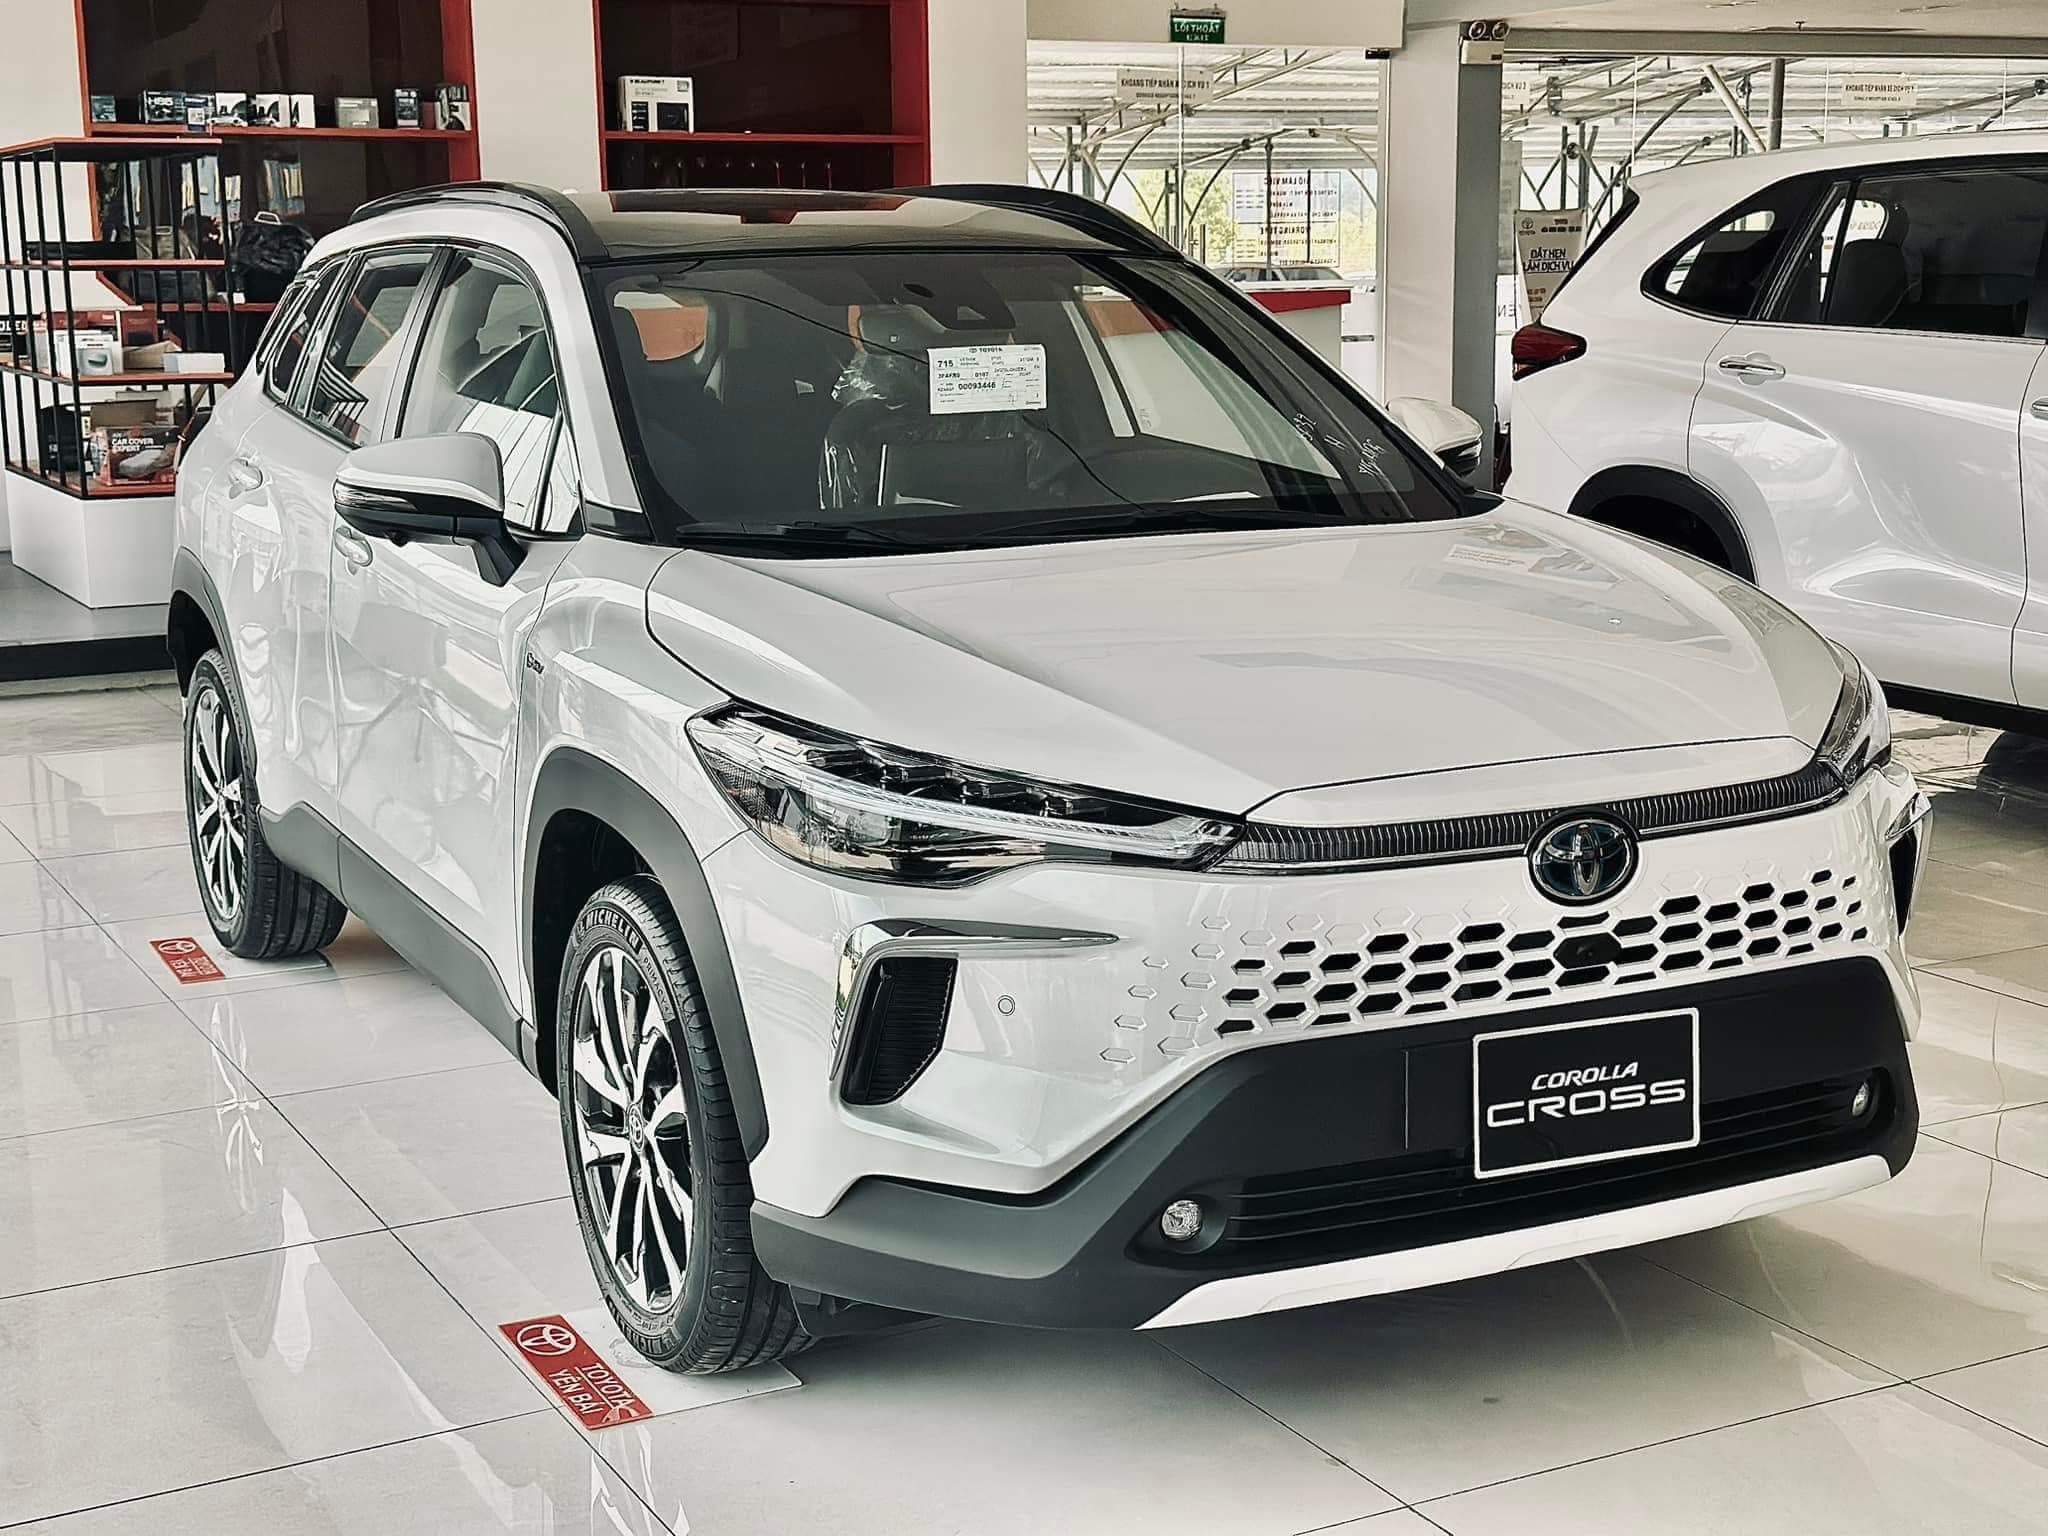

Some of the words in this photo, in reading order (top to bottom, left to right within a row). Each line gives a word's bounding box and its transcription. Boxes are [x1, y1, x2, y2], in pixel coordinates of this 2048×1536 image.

[1191, 21, 1219, 32] THOÁT
[586, 909, 640, 949] MICHELIN
[644, 957, 667, 1004] PRIMACY
[1531, 1061, 1639, 1091] COROLLA
[1487, 1079, 1686, 1128] CROSS
[549, 1369, 583, 1394] YÊN
[568, 1393, 607, 1415] BÁI
[582, 1362, 636, 1410] TOYOTA
